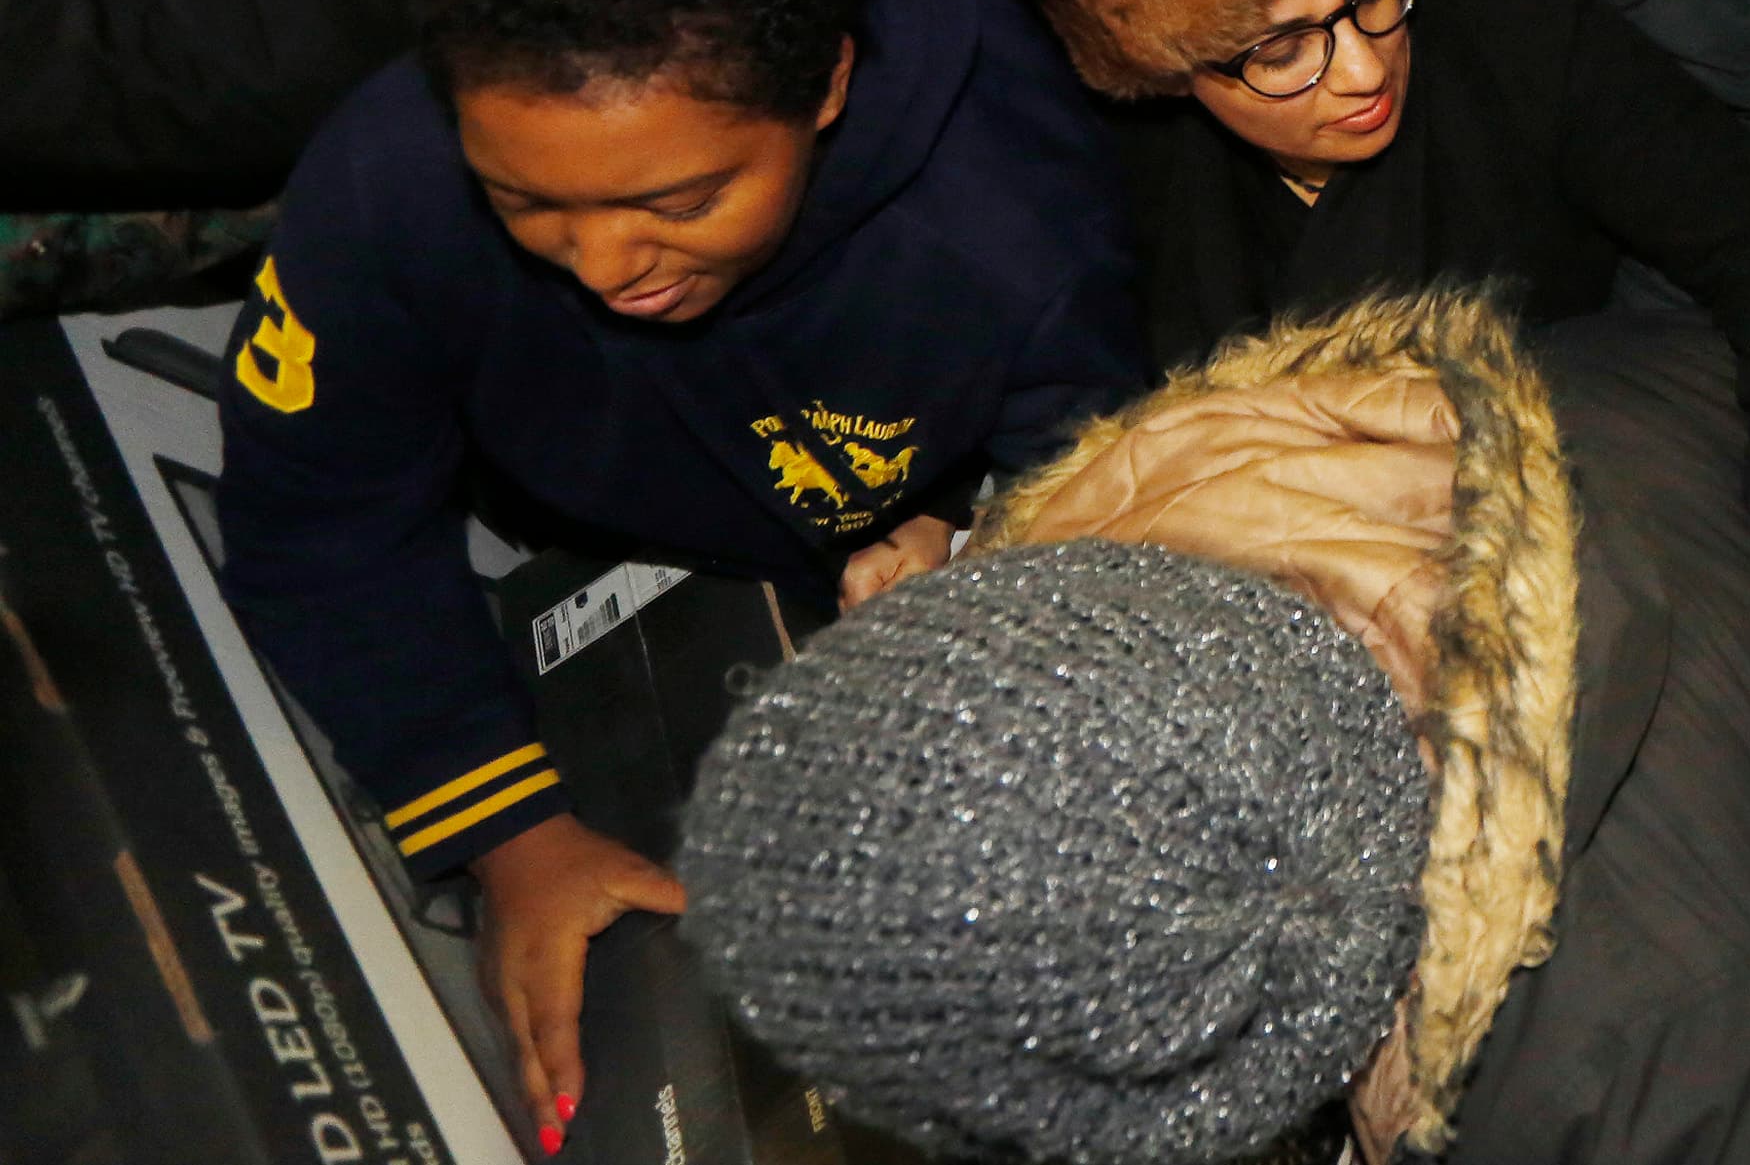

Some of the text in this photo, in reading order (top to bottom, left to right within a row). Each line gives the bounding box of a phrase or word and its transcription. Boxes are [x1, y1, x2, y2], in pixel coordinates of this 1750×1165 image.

[235, 254, 317, 414] 3
[105, 549, 141, 593] HD
[127, 592, 197, 721] Freeview
[200, 751, 261, 857] images
[194, 872, 266, 962] TV
[250, 861, 314, 967] quality
[249, 977, 334, 1100] LED
[301, 968, 374, 1091] (1080p)
[357, 1094, 401, 1150] HD
